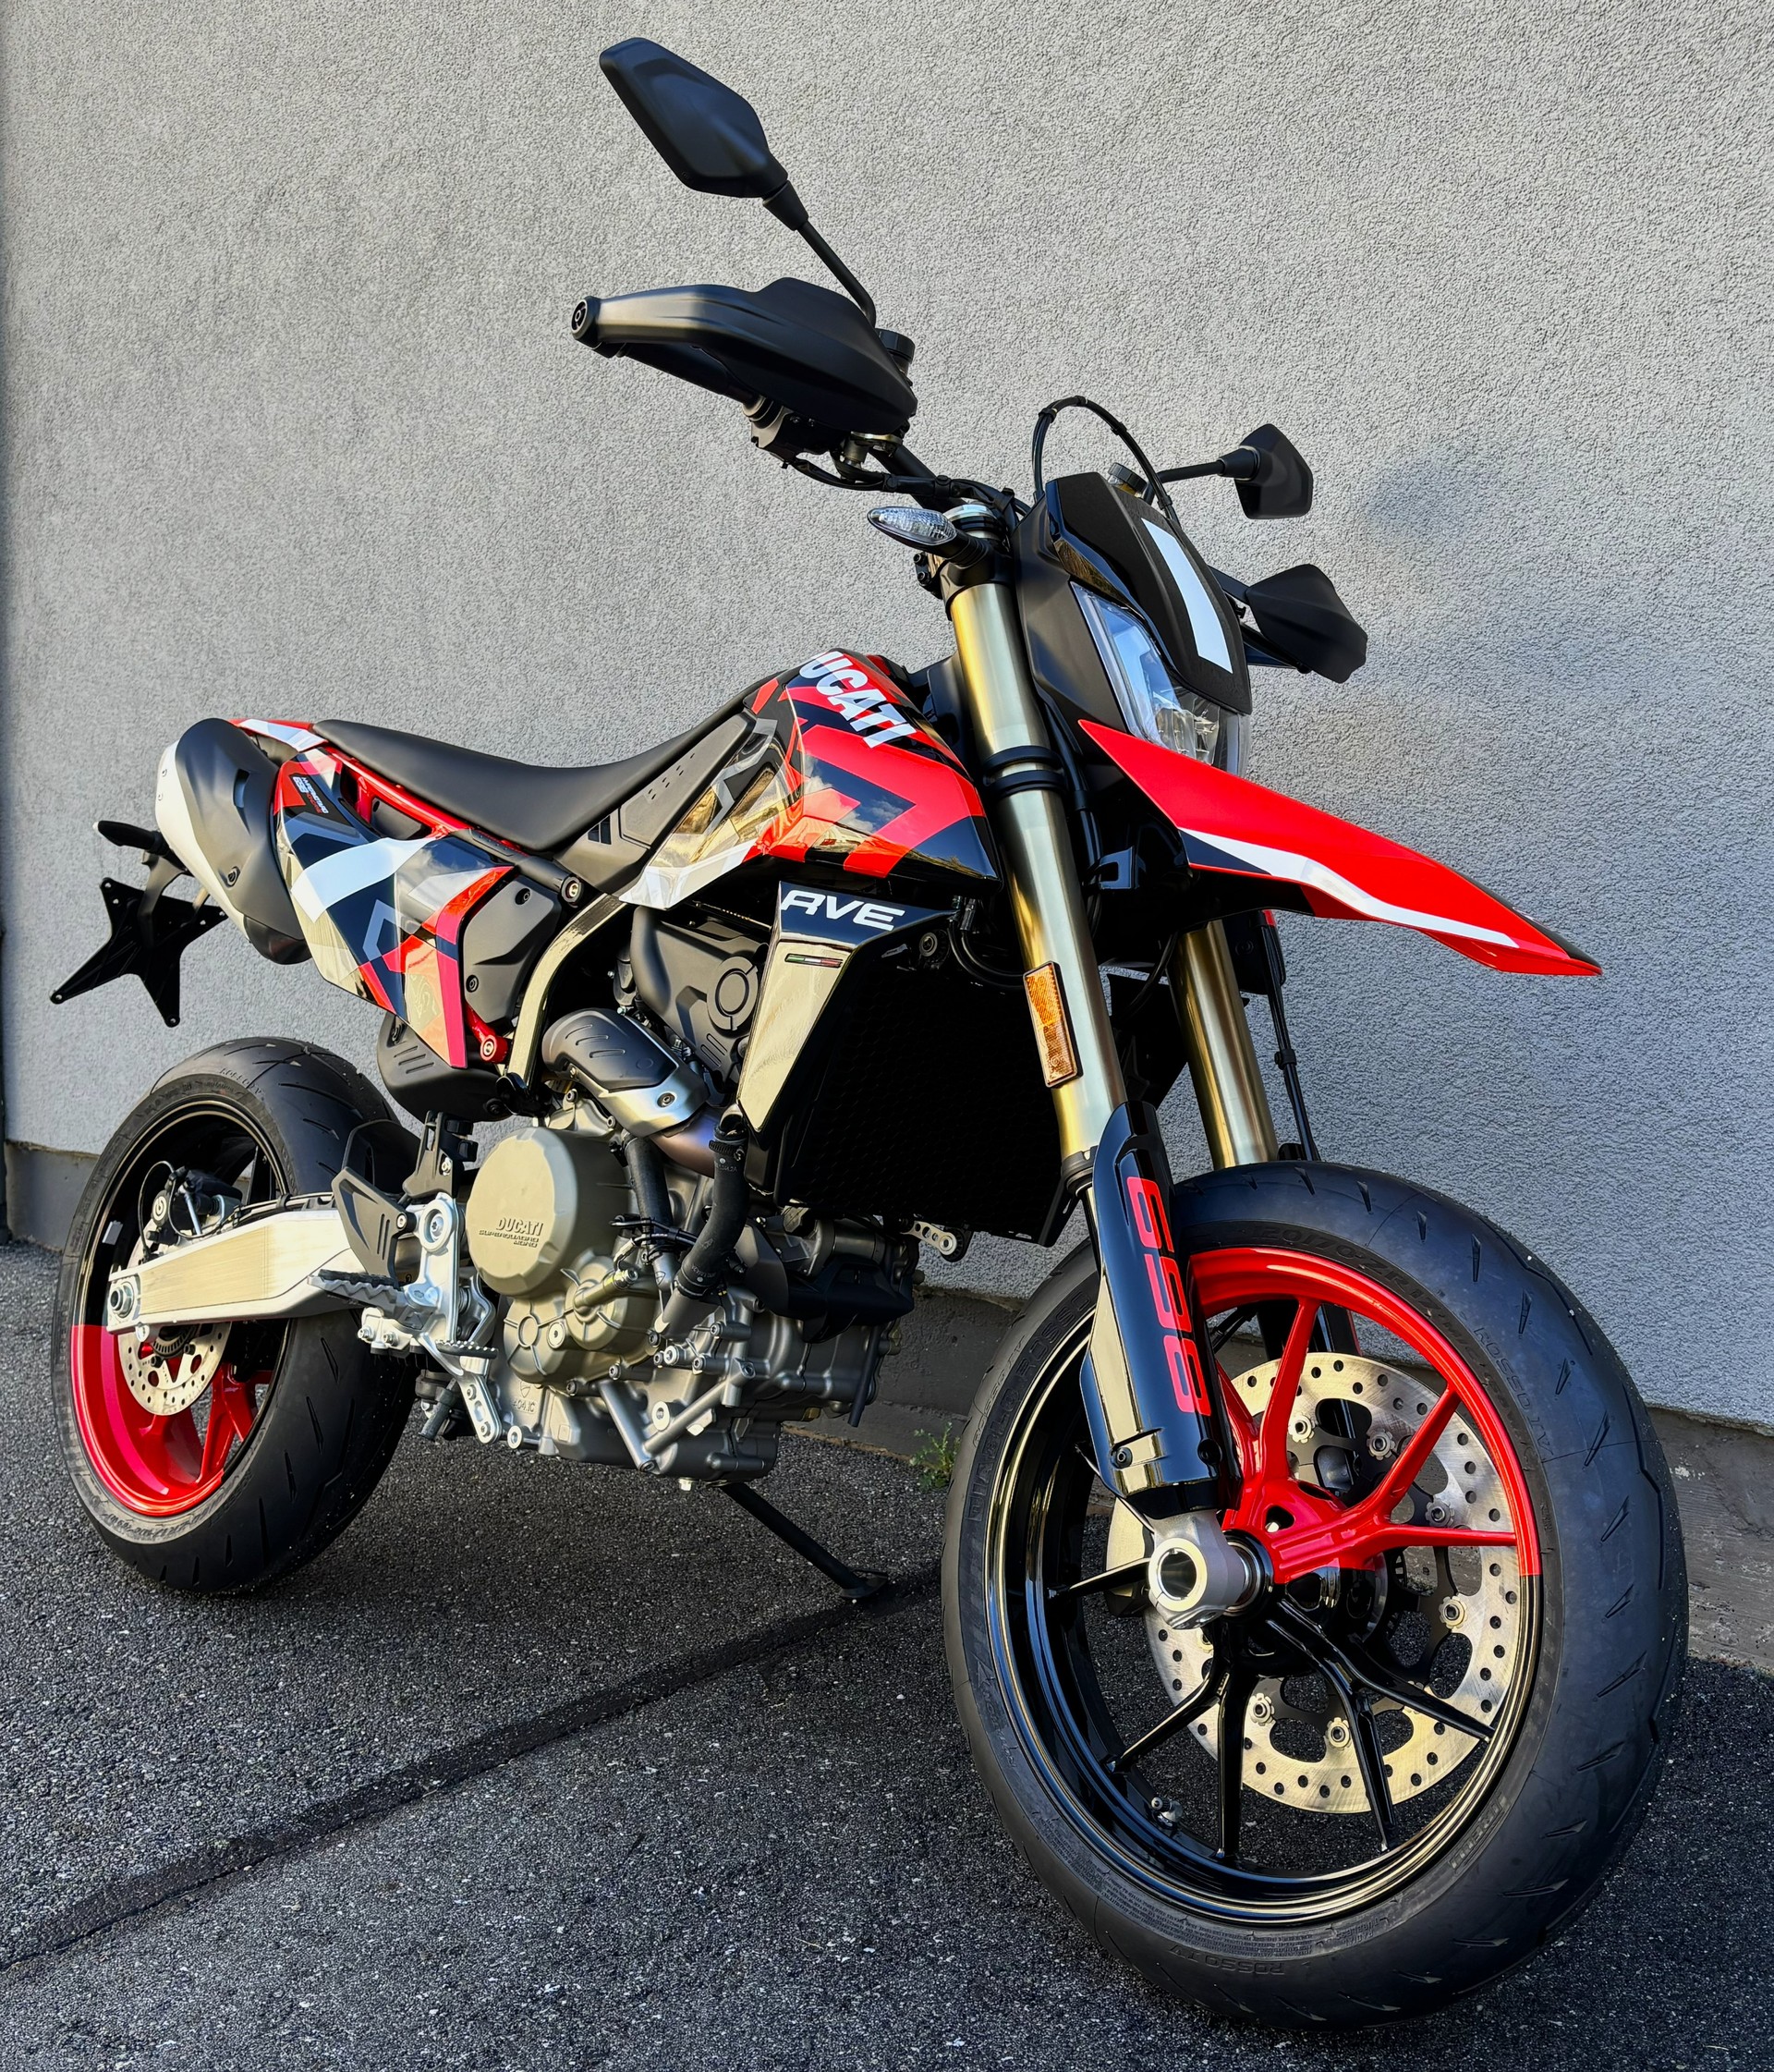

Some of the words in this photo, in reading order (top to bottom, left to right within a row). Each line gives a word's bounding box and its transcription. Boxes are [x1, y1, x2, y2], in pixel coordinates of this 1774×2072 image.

[781, 890, 905, 932] RVE
[496, 1217, 544, 1237] DUCATI
[1127, 1176, 1211, 1416] 698
[967, 1383, 1022, 1520] DIABLO
[1017, 1291, 1092, 1381] ROSSO
[1476, 1328, 1532, 1411] ROSSO
